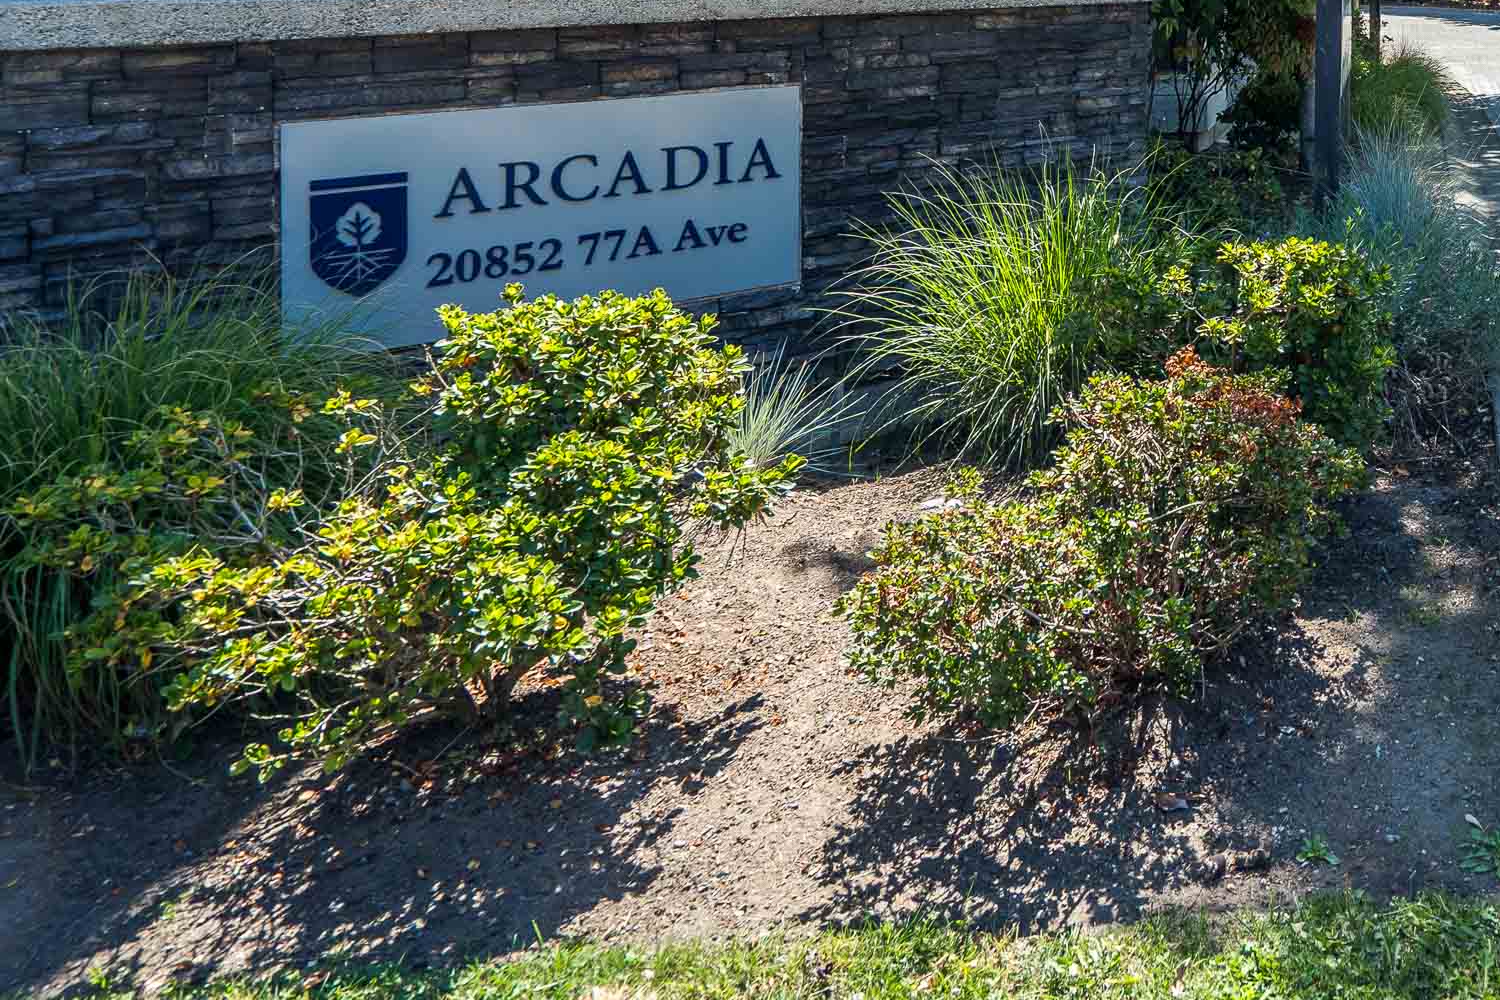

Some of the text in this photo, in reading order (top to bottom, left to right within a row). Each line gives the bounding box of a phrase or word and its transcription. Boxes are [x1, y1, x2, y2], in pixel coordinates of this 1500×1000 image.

[433, 137, 782, 219] ARCADIA
[425, 219, 749, 289] 20852 77A Ave
